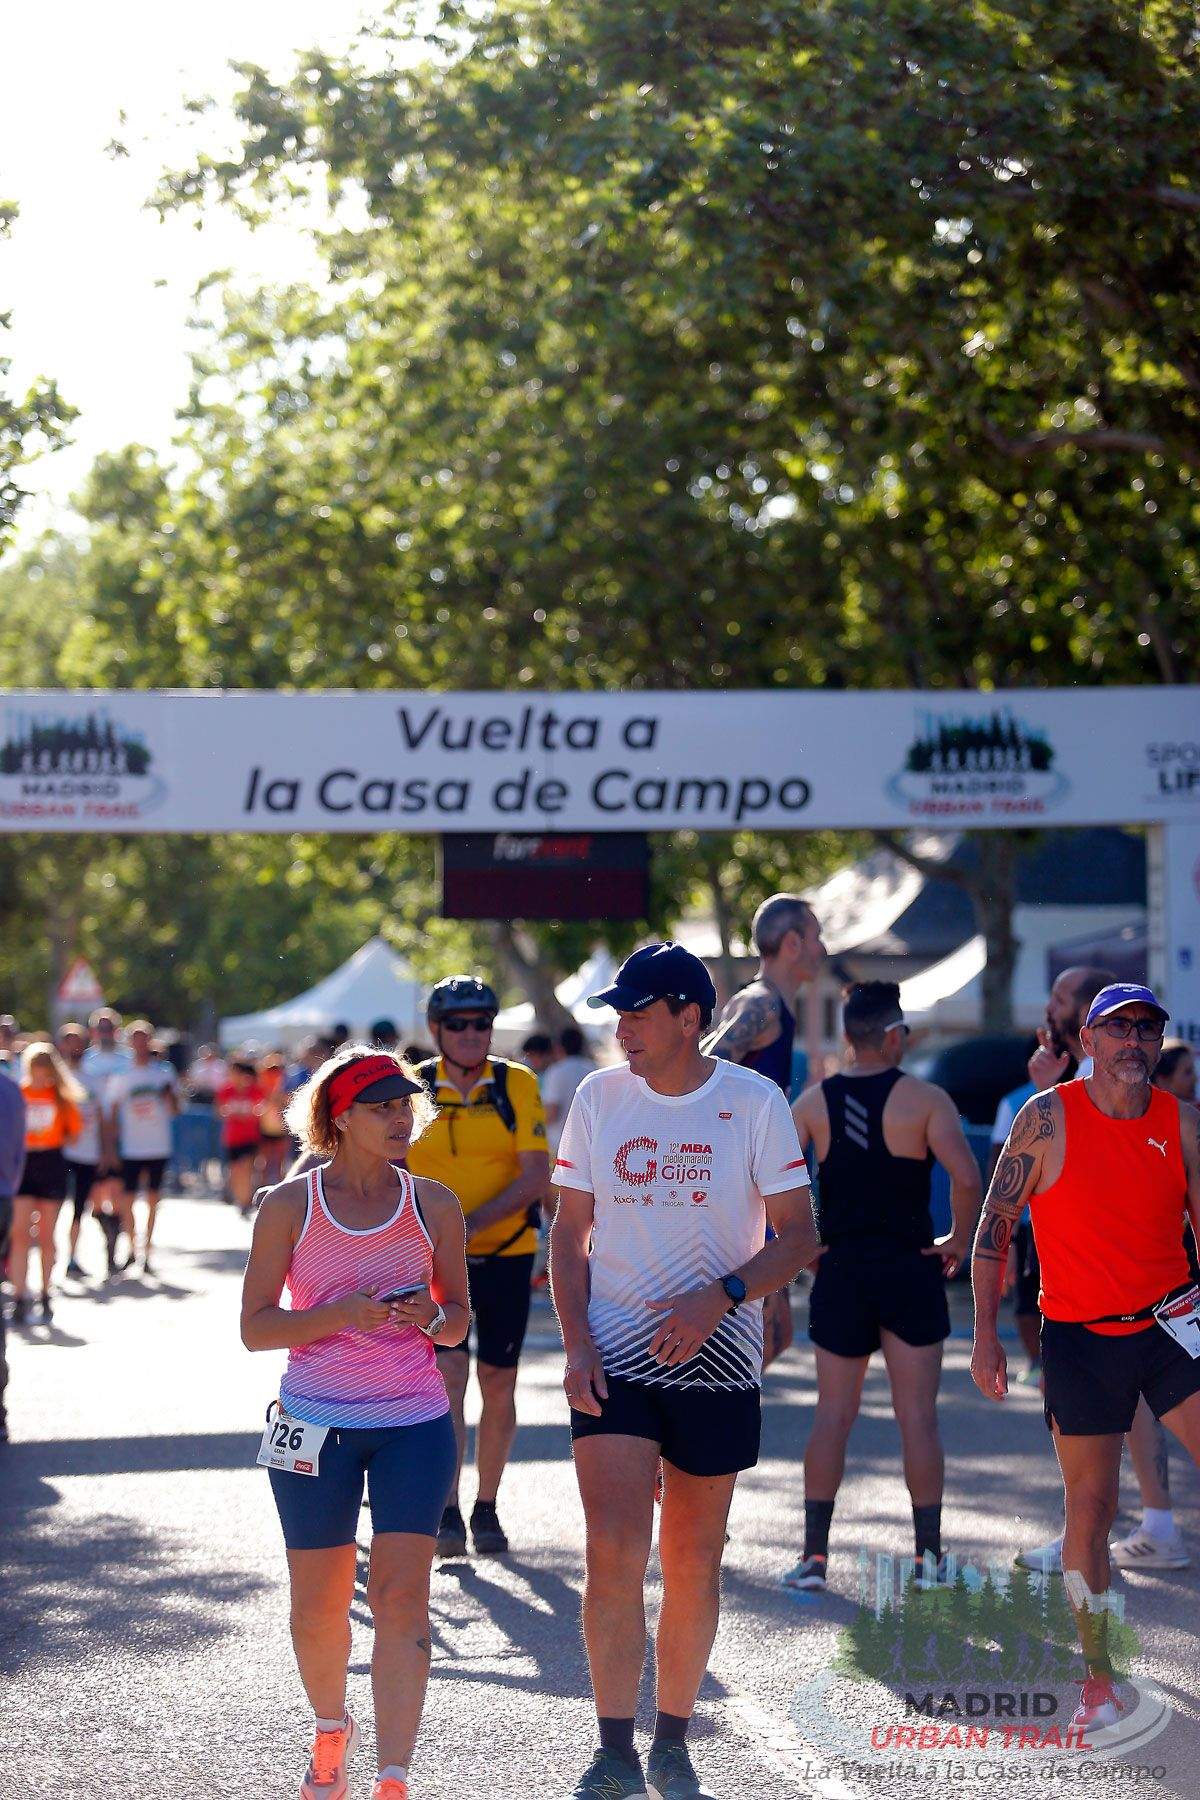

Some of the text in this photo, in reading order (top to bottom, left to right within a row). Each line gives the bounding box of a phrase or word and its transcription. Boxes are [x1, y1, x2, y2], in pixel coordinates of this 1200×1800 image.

[398, 706, 660, 752] Vuelta a
[1145, 743, 1200, 767] SPO
[245, 767, 813, 821] la Casa de Campo
[662, 1154, 713, 1166] media maratón
[679, 1143, 713, 1154] MBA
[661, 1164, 711, 1184] Gijón
[269, 1421, 305, 1451] 126
